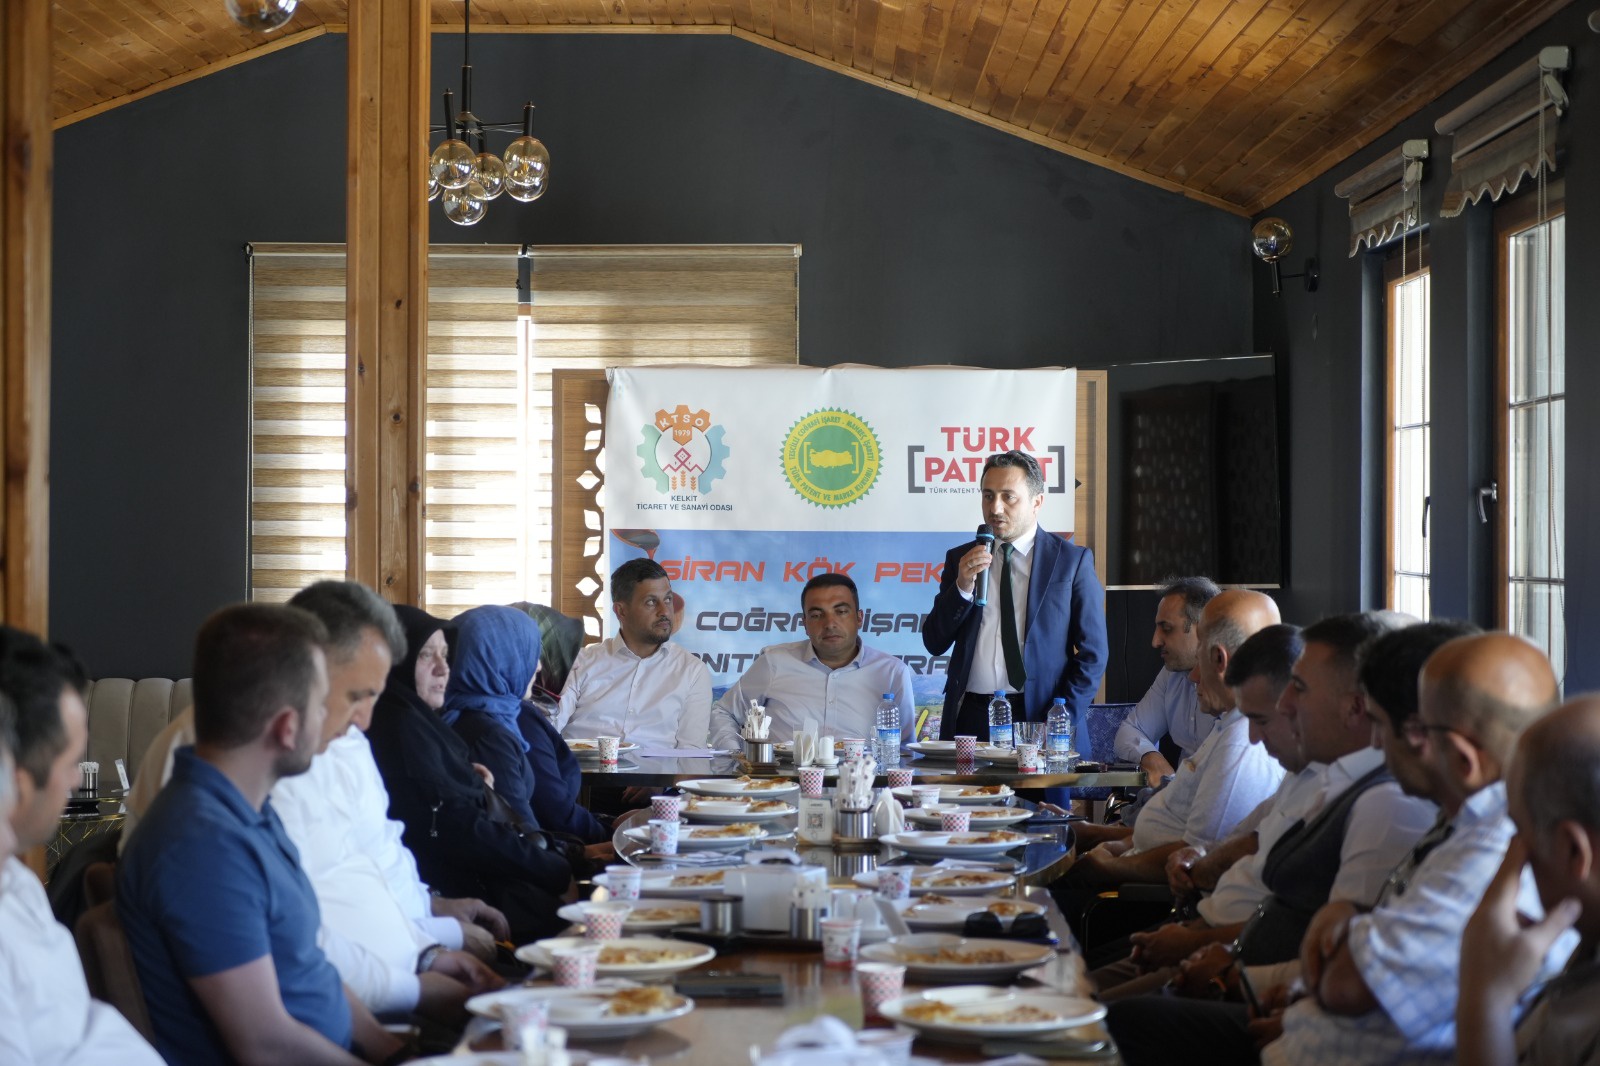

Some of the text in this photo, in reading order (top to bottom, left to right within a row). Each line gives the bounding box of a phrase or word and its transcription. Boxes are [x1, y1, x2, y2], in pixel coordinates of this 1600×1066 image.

[660, 414, 704, 428] KTSO
[941, 427, 1035, 452] TÜRK
[924, 457, 1053, 482] PATT
[790, 466, 873, 501] TÜRK PATENT VE MARKA KURUMU
[929, 486, 948, 494] TÜRK
[636, 502, 667, 510] TİCARET
[681, 502, 709, 511] SANAYİ
[783, 556, 856, 583] KÖK
[873, 562, 945, 584] PEK
